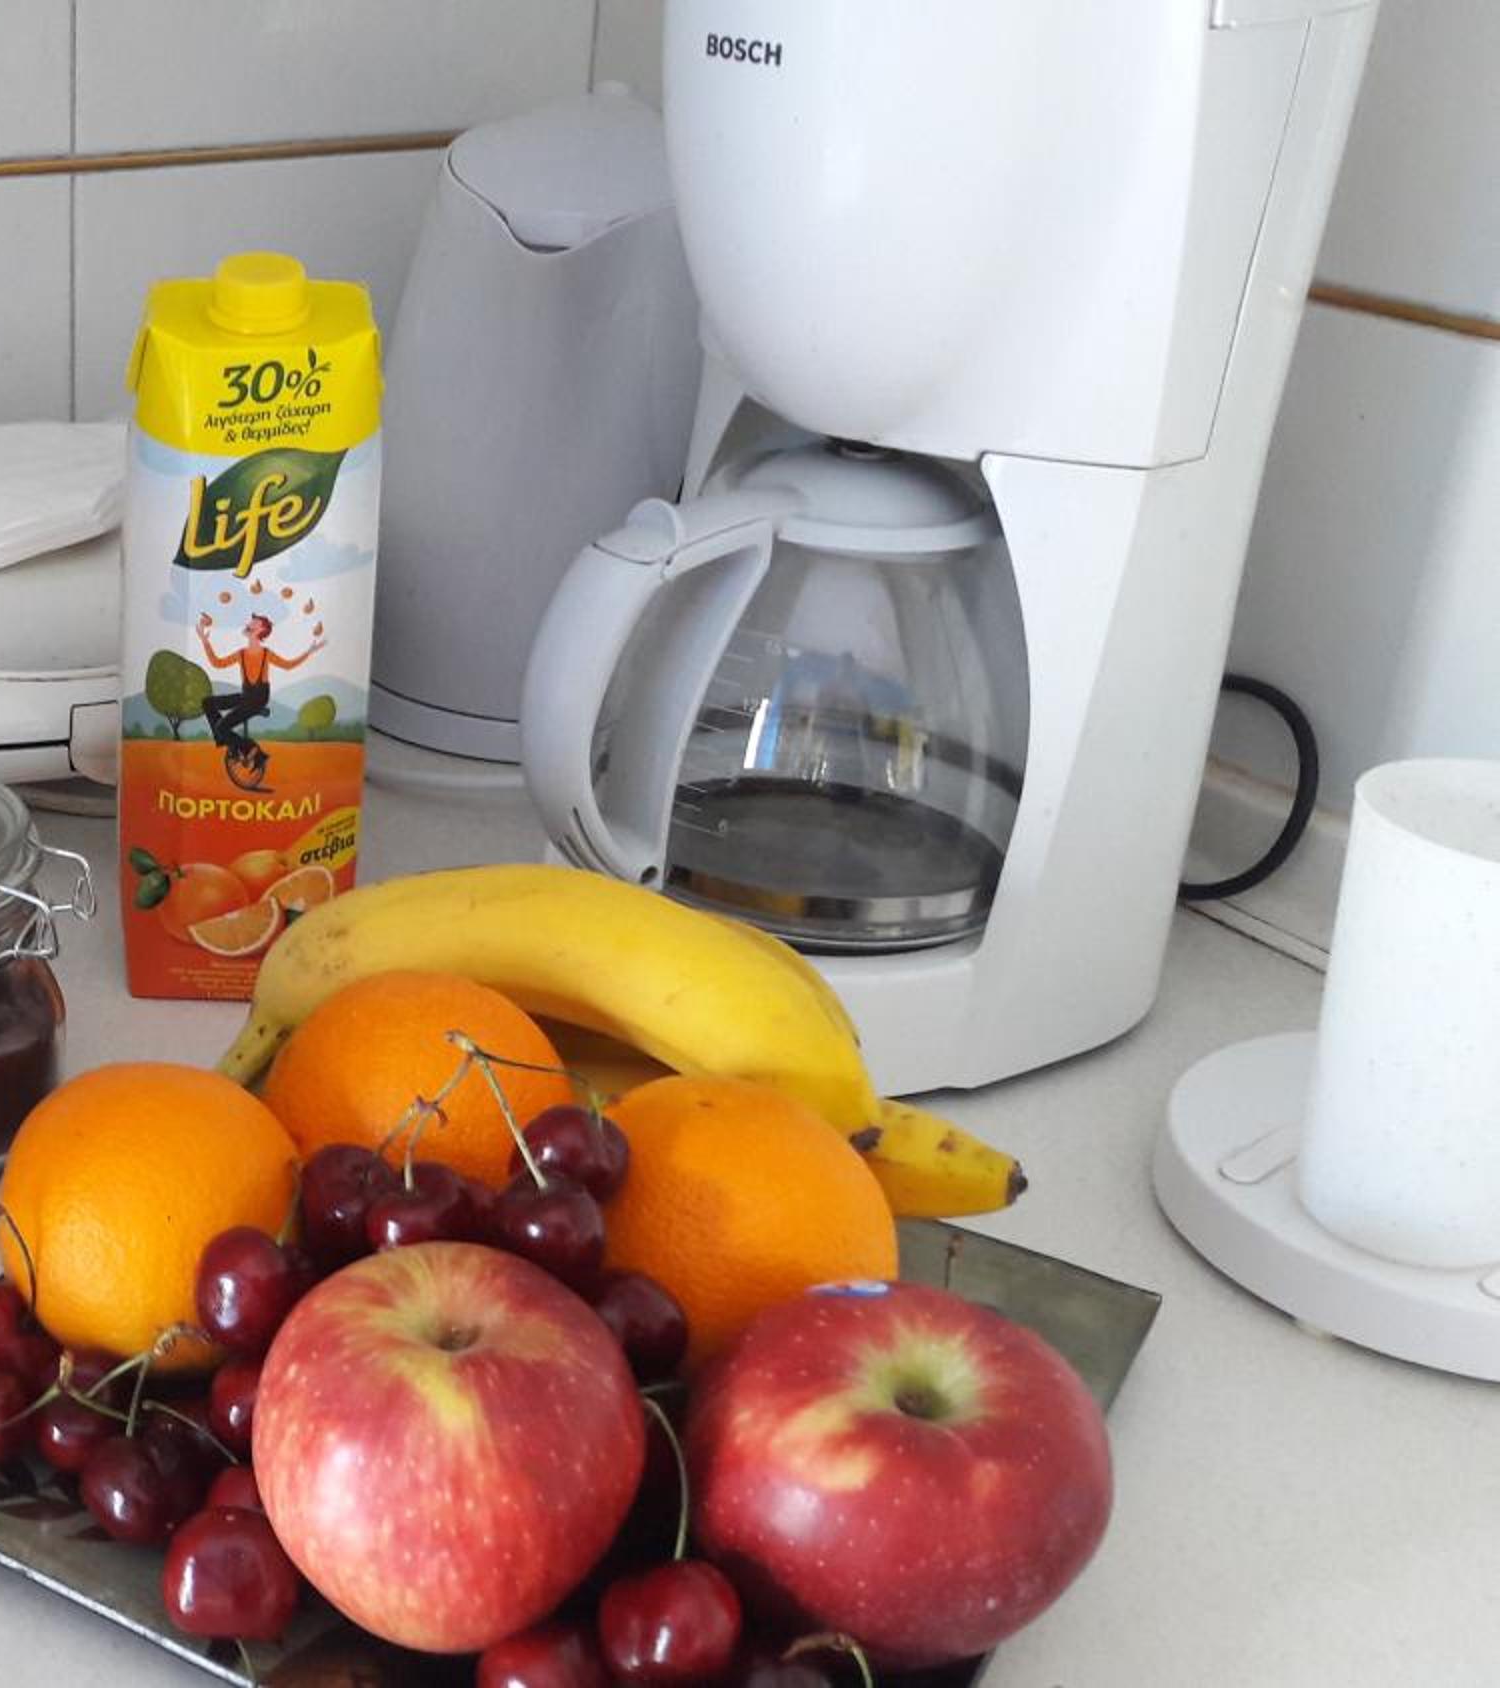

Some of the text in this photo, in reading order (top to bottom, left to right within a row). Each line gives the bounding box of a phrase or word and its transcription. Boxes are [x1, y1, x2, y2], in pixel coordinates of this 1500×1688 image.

[706, 33, 782, 67] BOSCH
[217, 357, 325, 408] 30%
[224, 429, 237, 442] &
[184, 472, 322, 578] Life
[158, 789, 321, 821] ΠΟΡΤΟΚΑΛΙ
